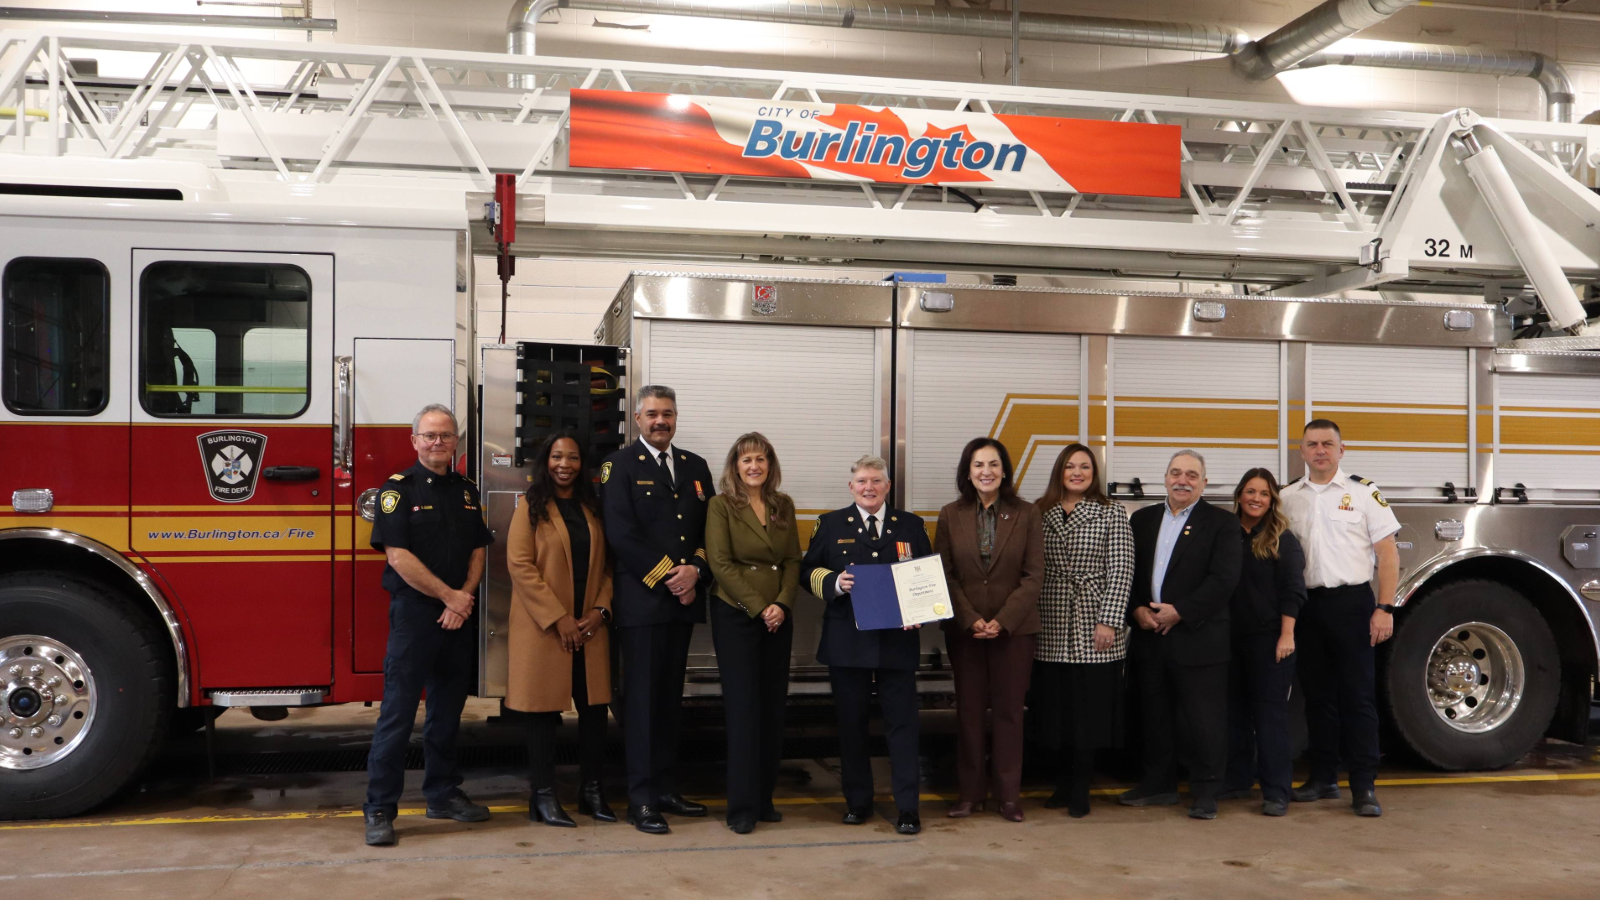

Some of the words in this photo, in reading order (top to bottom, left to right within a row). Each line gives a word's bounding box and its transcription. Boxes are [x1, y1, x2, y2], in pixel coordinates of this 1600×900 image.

[758, 106, 794, 118] CITY
[800, 109, 820, 119] OF
[742, 119, 1027, 178] Burlington
[1424, 238, 1450, 258] 32
[1460, 245, 1473, 258] M
[207, 435, 258, 445] BURLINGTON
[214, 485, 230, 494] FIRE
[231, 485, 250, 494] DEPT.
